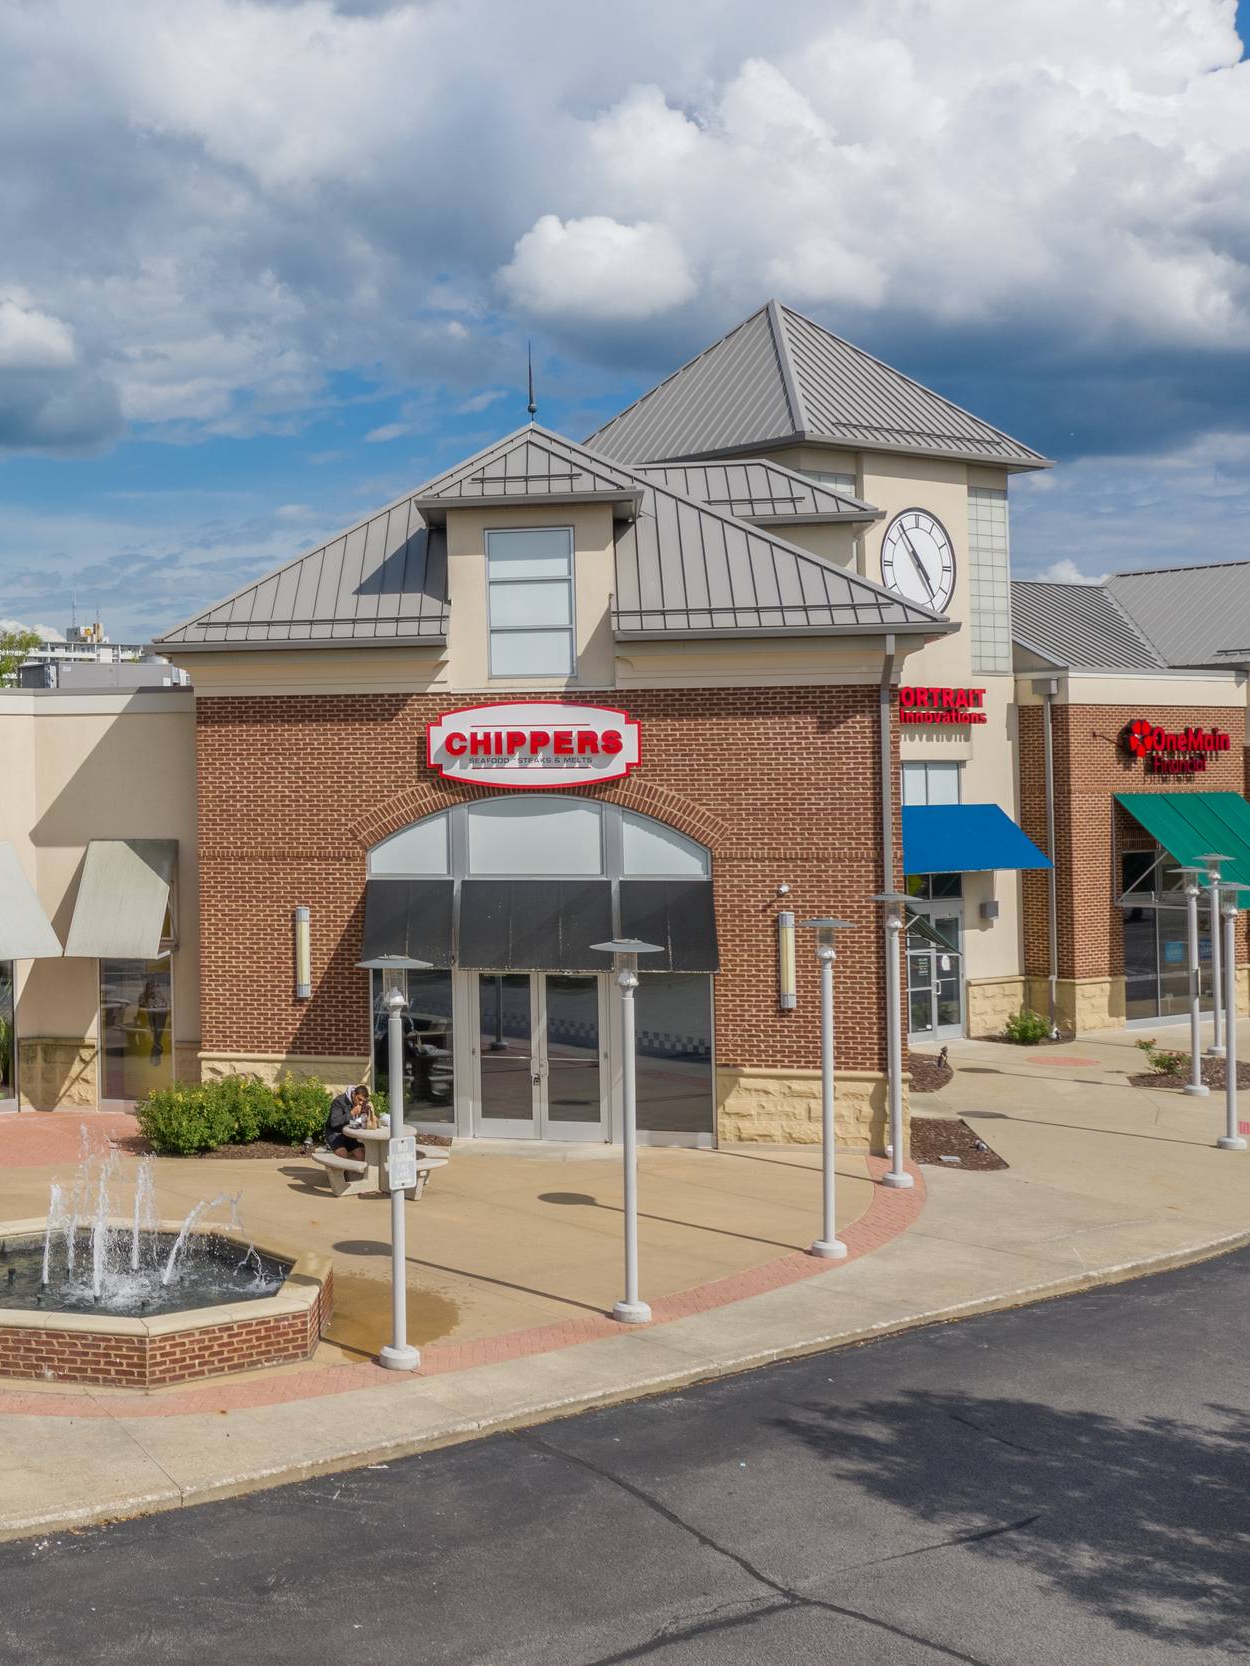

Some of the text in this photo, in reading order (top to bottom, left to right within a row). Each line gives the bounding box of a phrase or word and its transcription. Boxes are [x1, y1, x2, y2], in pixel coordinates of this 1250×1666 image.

[899, 686, 986, 708] ORTRAIT
[899, 708, 988, 724] Innovations
[445, 729, 623, 756] CHIPPERS
[1152, 726, 1231, 752] OneMain
[517, 756, 551, 764] STEAKS
[554, 756, 561, 764] &
[563, 756, 593, 764] MELTS
[1153, 754, 1207, 773] Financial
